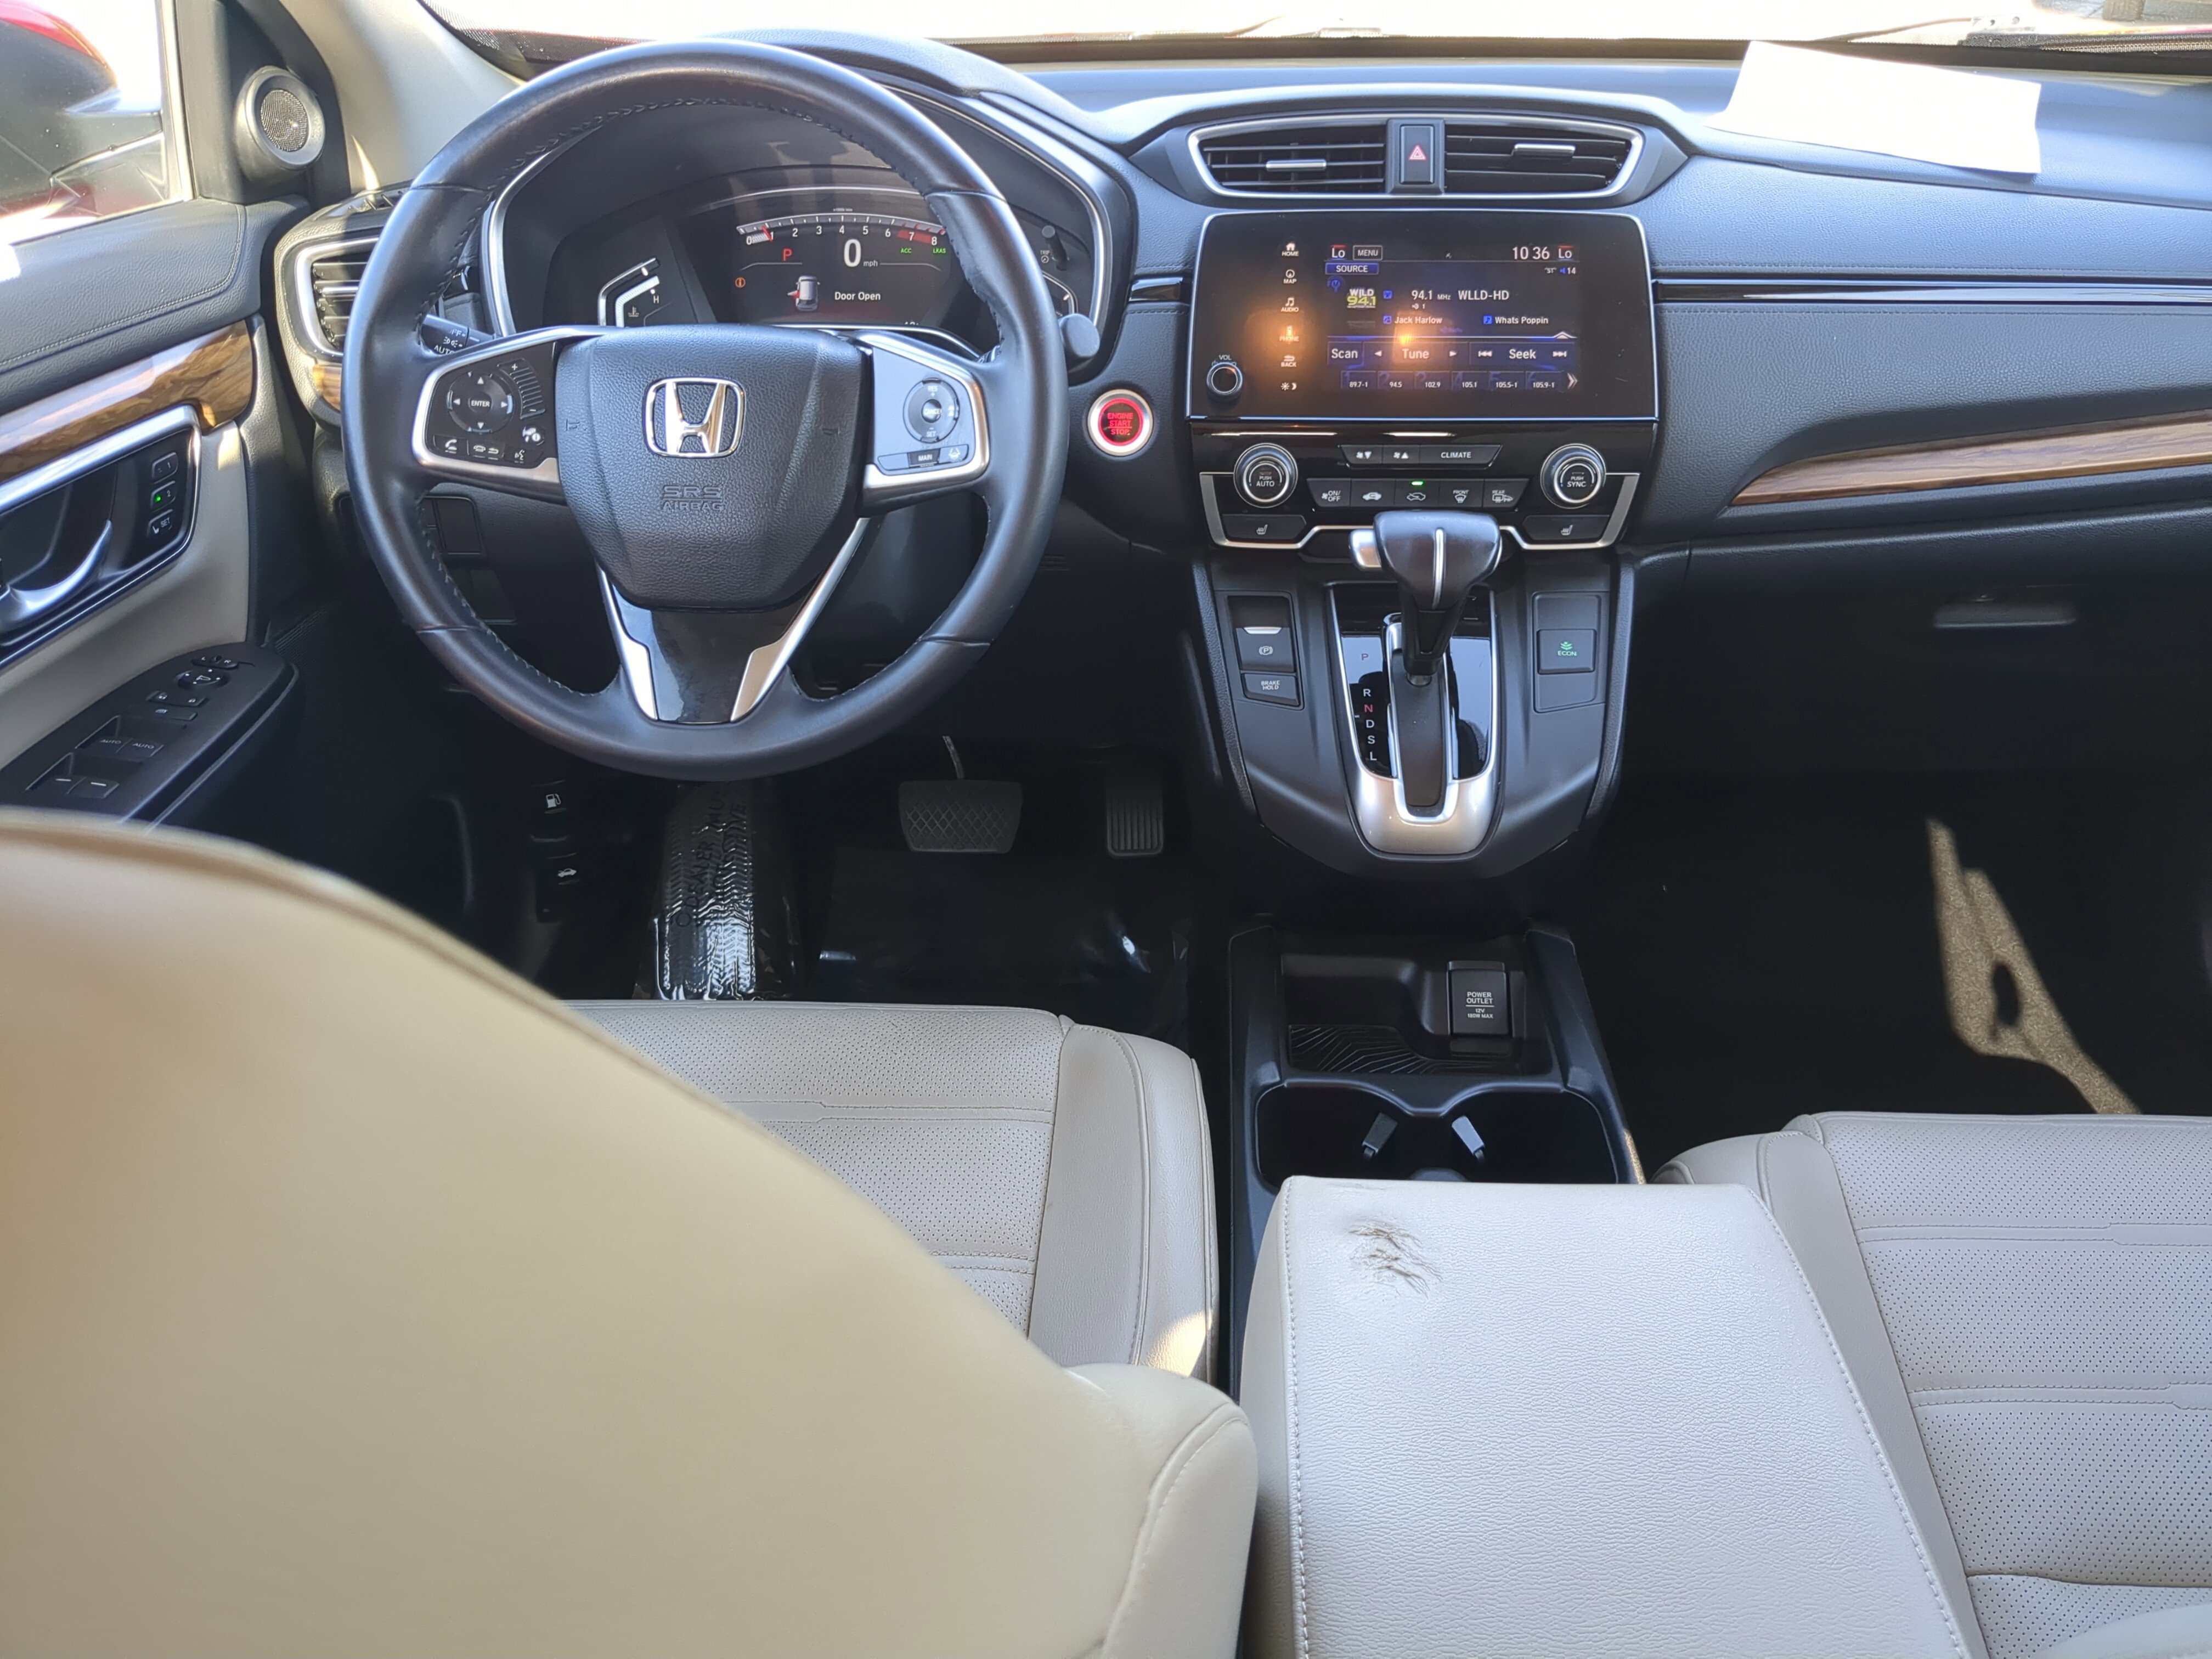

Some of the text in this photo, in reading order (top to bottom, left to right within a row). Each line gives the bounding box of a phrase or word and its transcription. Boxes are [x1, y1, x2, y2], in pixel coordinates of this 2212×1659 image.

[746, 236, 752, 245] 0
[792, 228, 798, 237] 2
[816, 225, 822, 234] 3
[839, 225, 845, 234] 4
[862, 225, 868, 234] 5
[885, 228, 891, 237] 6
[909, 232, 915, 241] 7
[932, 236, 937, 245] 8
[783, 248, 792, 261] P
[844, 239, 861, 267] 0
[1331, 247, 1345, 258] Lo
[1558, 248, 1572, 258] Lo
[834, 291, 881, 301] Door Open
[1349, 289, 1374, 297] WILD
[1411, 290, 1433, 300] 94.1
[1458, 290, 1509, 300] WLLD-HD
[653, 295, 659, 304] H
[1347, 296, 1376, 306] 94.1
[1394, 316, 1442, 324] Jack Harlow
[1521, 317, 1549, 325] Poppin
[1331, 348, 1358, 359] Scan
[1402, 348, 1429, 359] Tune
[1509, 349, 1536, 359] Seek
[662, 485, 721, 498] SRS
[662, 501, 725, 511] AIRBAG
[161, 517, 171, 528] SET
[1363, 689, 1372, 697] R
[1366, 719, 1375, 728] D
[1368, 735, 1375, 744] S
[1370, 752, 1377, 760] L
